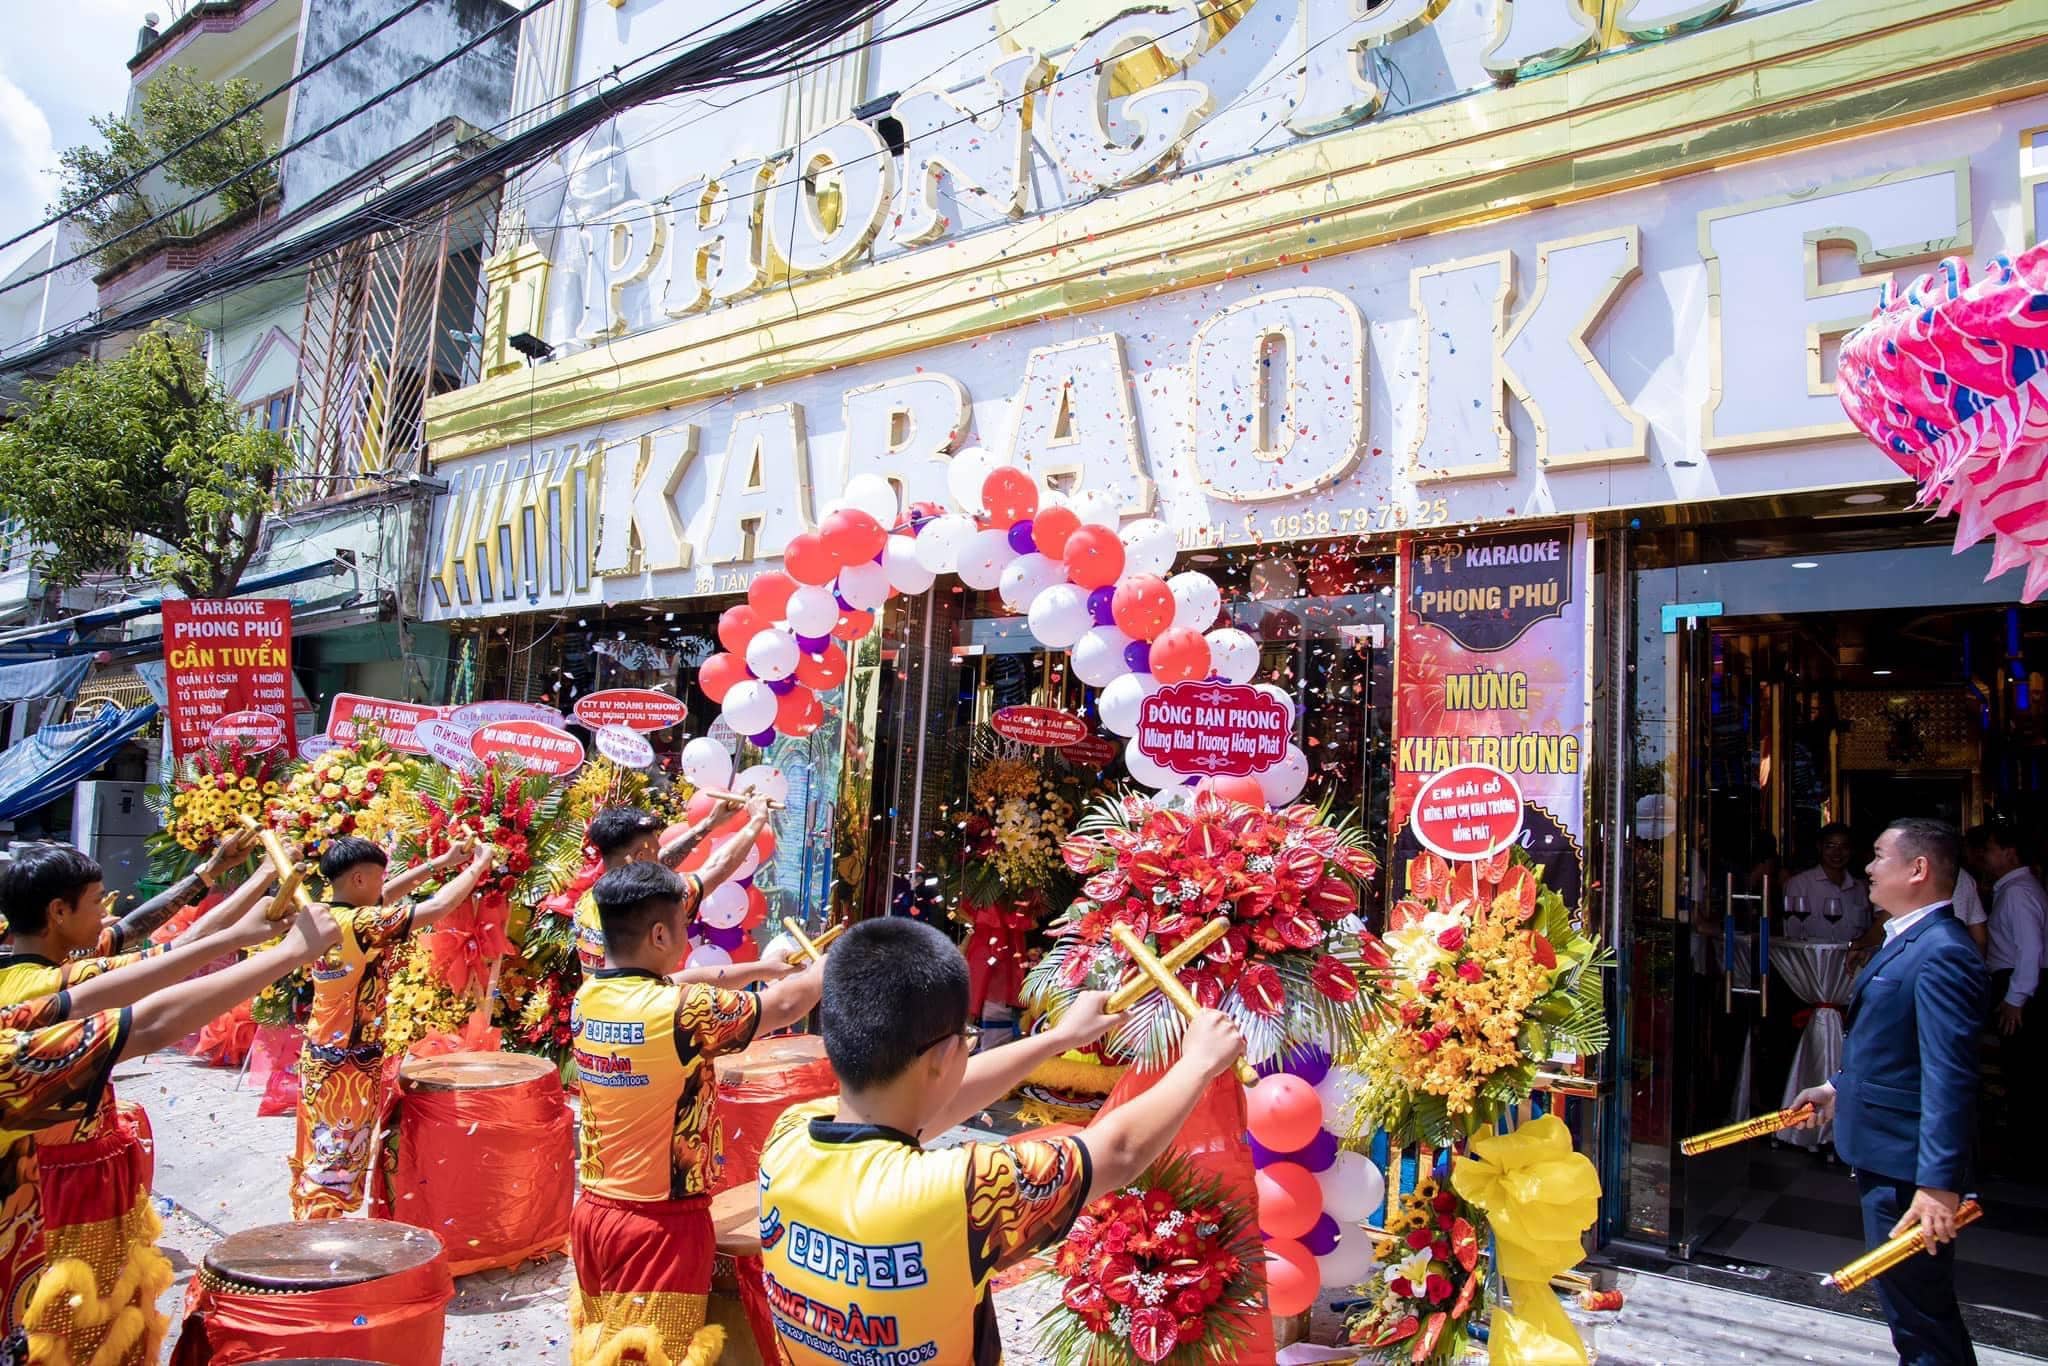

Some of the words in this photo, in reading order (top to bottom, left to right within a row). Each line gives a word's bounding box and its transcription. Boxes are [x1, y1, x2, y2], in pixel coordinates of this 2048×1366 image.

[575, 0, 1218, 347] PHONG
[593, 156, 1975, 577] KARAOKE
[1271, 510, 1331, 538] 0938
[1338, 507, 1369, 531] 79
[1415, 497, 1449, 523] 25
[1466, 541, 1561, 568] KARAOKE
[719, 566, 749, 592] TÂN
[190, 601, 266, 616] KARAOKE
[1421, 585, 1503, 614] PHONG
[1508, 577, 1560, 608] PHÚ
[174, 620, 240, 639] PHONG
[244, 617, 283, 638] PHÚ
[169, 639, 215, 669] CẦN
[219, 638, 288, 668] TUYỂN
[1445, 664, 1528, 712] MỪNG
[179, 706, 198, 717] THU
[389, 708, 419, 725] TENNIS
[613, 700, 644, 710] HOÀNG
[1148, 701, 1192, 725] ĐÔNG
[1195, 706, 1225, 730] BẠN
[1228, 709, 1280, 730] PHONG
[1173, 729, 1194, 749] Khai
[1257, 734, 1280, 755] Phát
[1399, 735, 1461, 773] KHAI
[1468, 730, 1580, 775] TRƯƠNG
[585, 1019, 645, 1045] COFFEE
[787, 1221, 928, 1289] COFFEE
[806, 1303, 899, 1347] TRẦN
[806, 1334, 848, 1363] nguyên
[849, 1347, 882, 1366] chất
[889, 1341, 938, 1366] 100%
